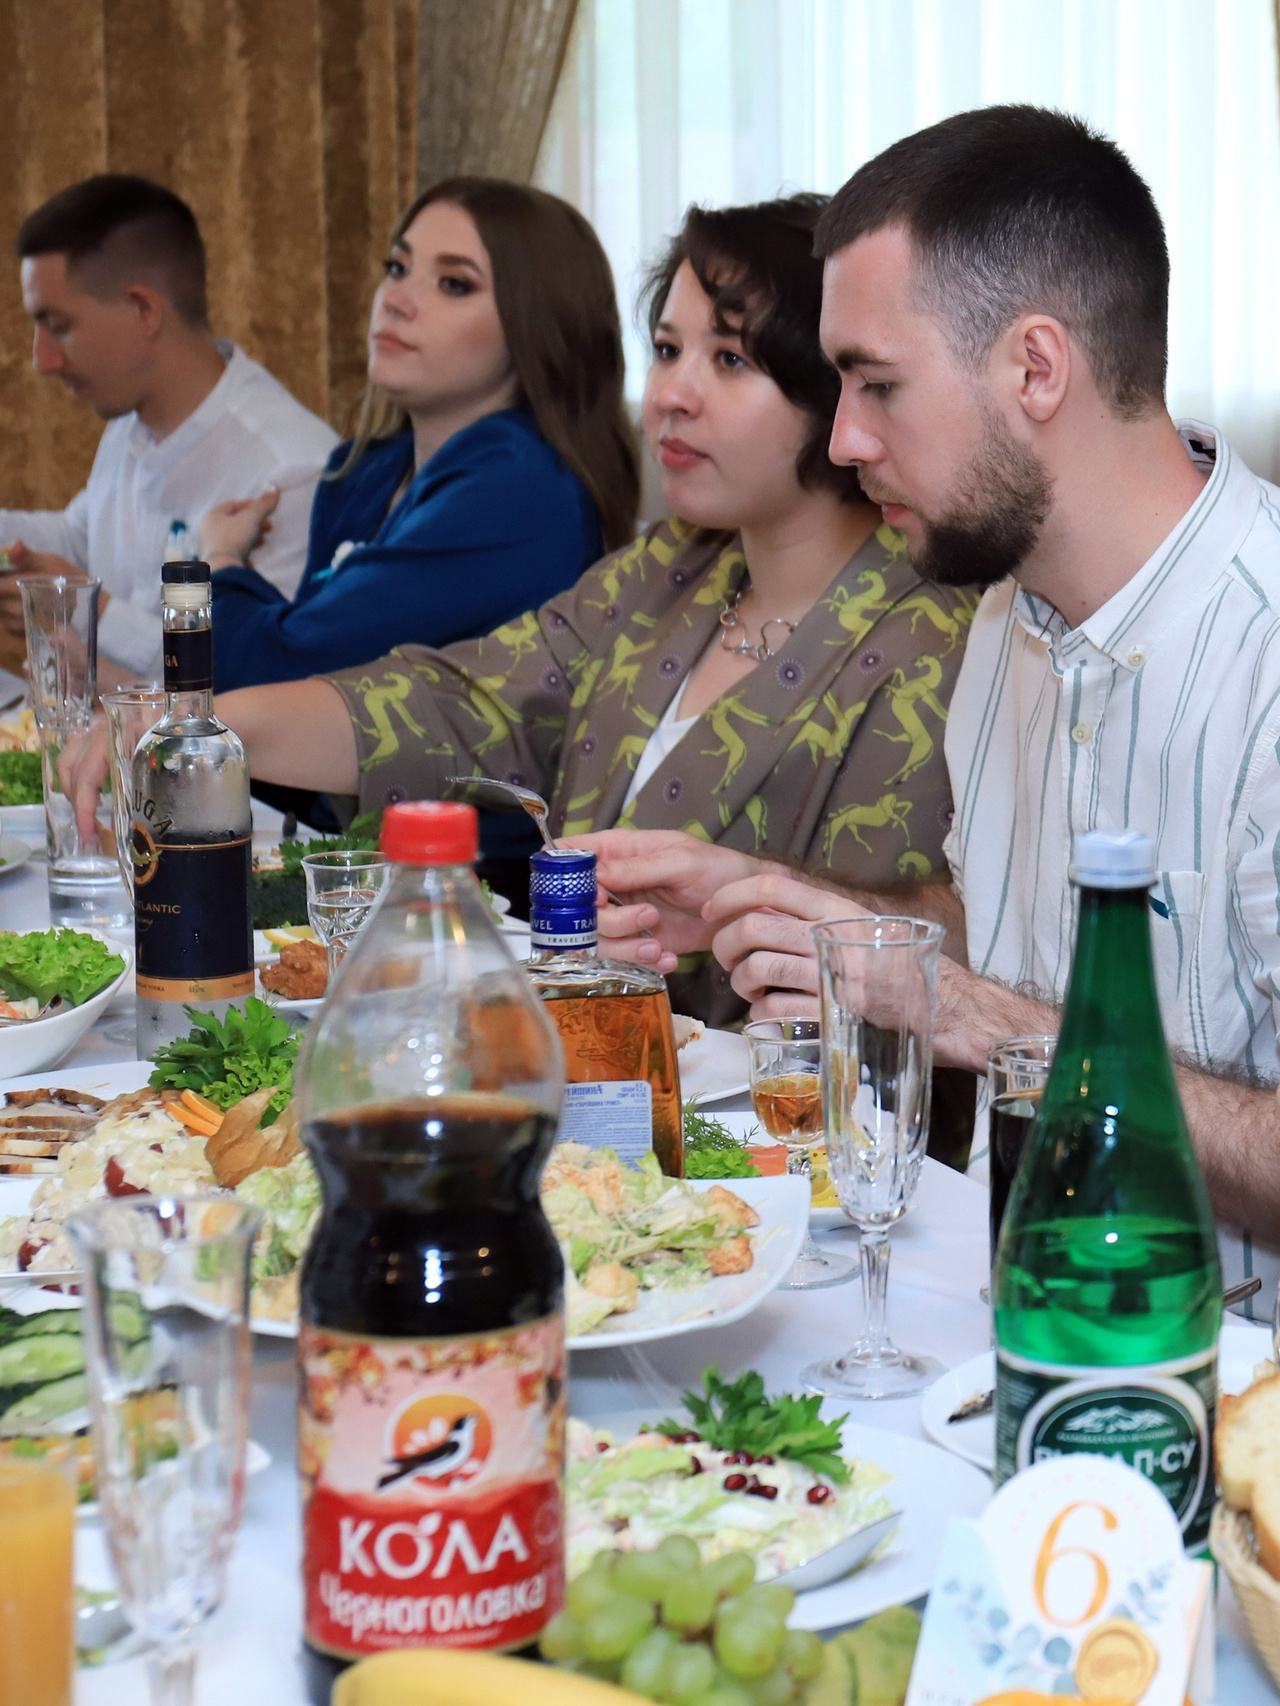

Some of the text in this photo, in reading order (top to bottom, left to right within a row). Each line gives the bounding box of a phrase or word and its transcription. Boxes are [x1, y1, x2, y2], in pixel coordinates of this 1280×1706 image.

[338, 1511, 529, 1580] КОЛА
[1034, 1499, 1118, 1628] 6
[319, 1569, 547, 1643] Черноголовка
